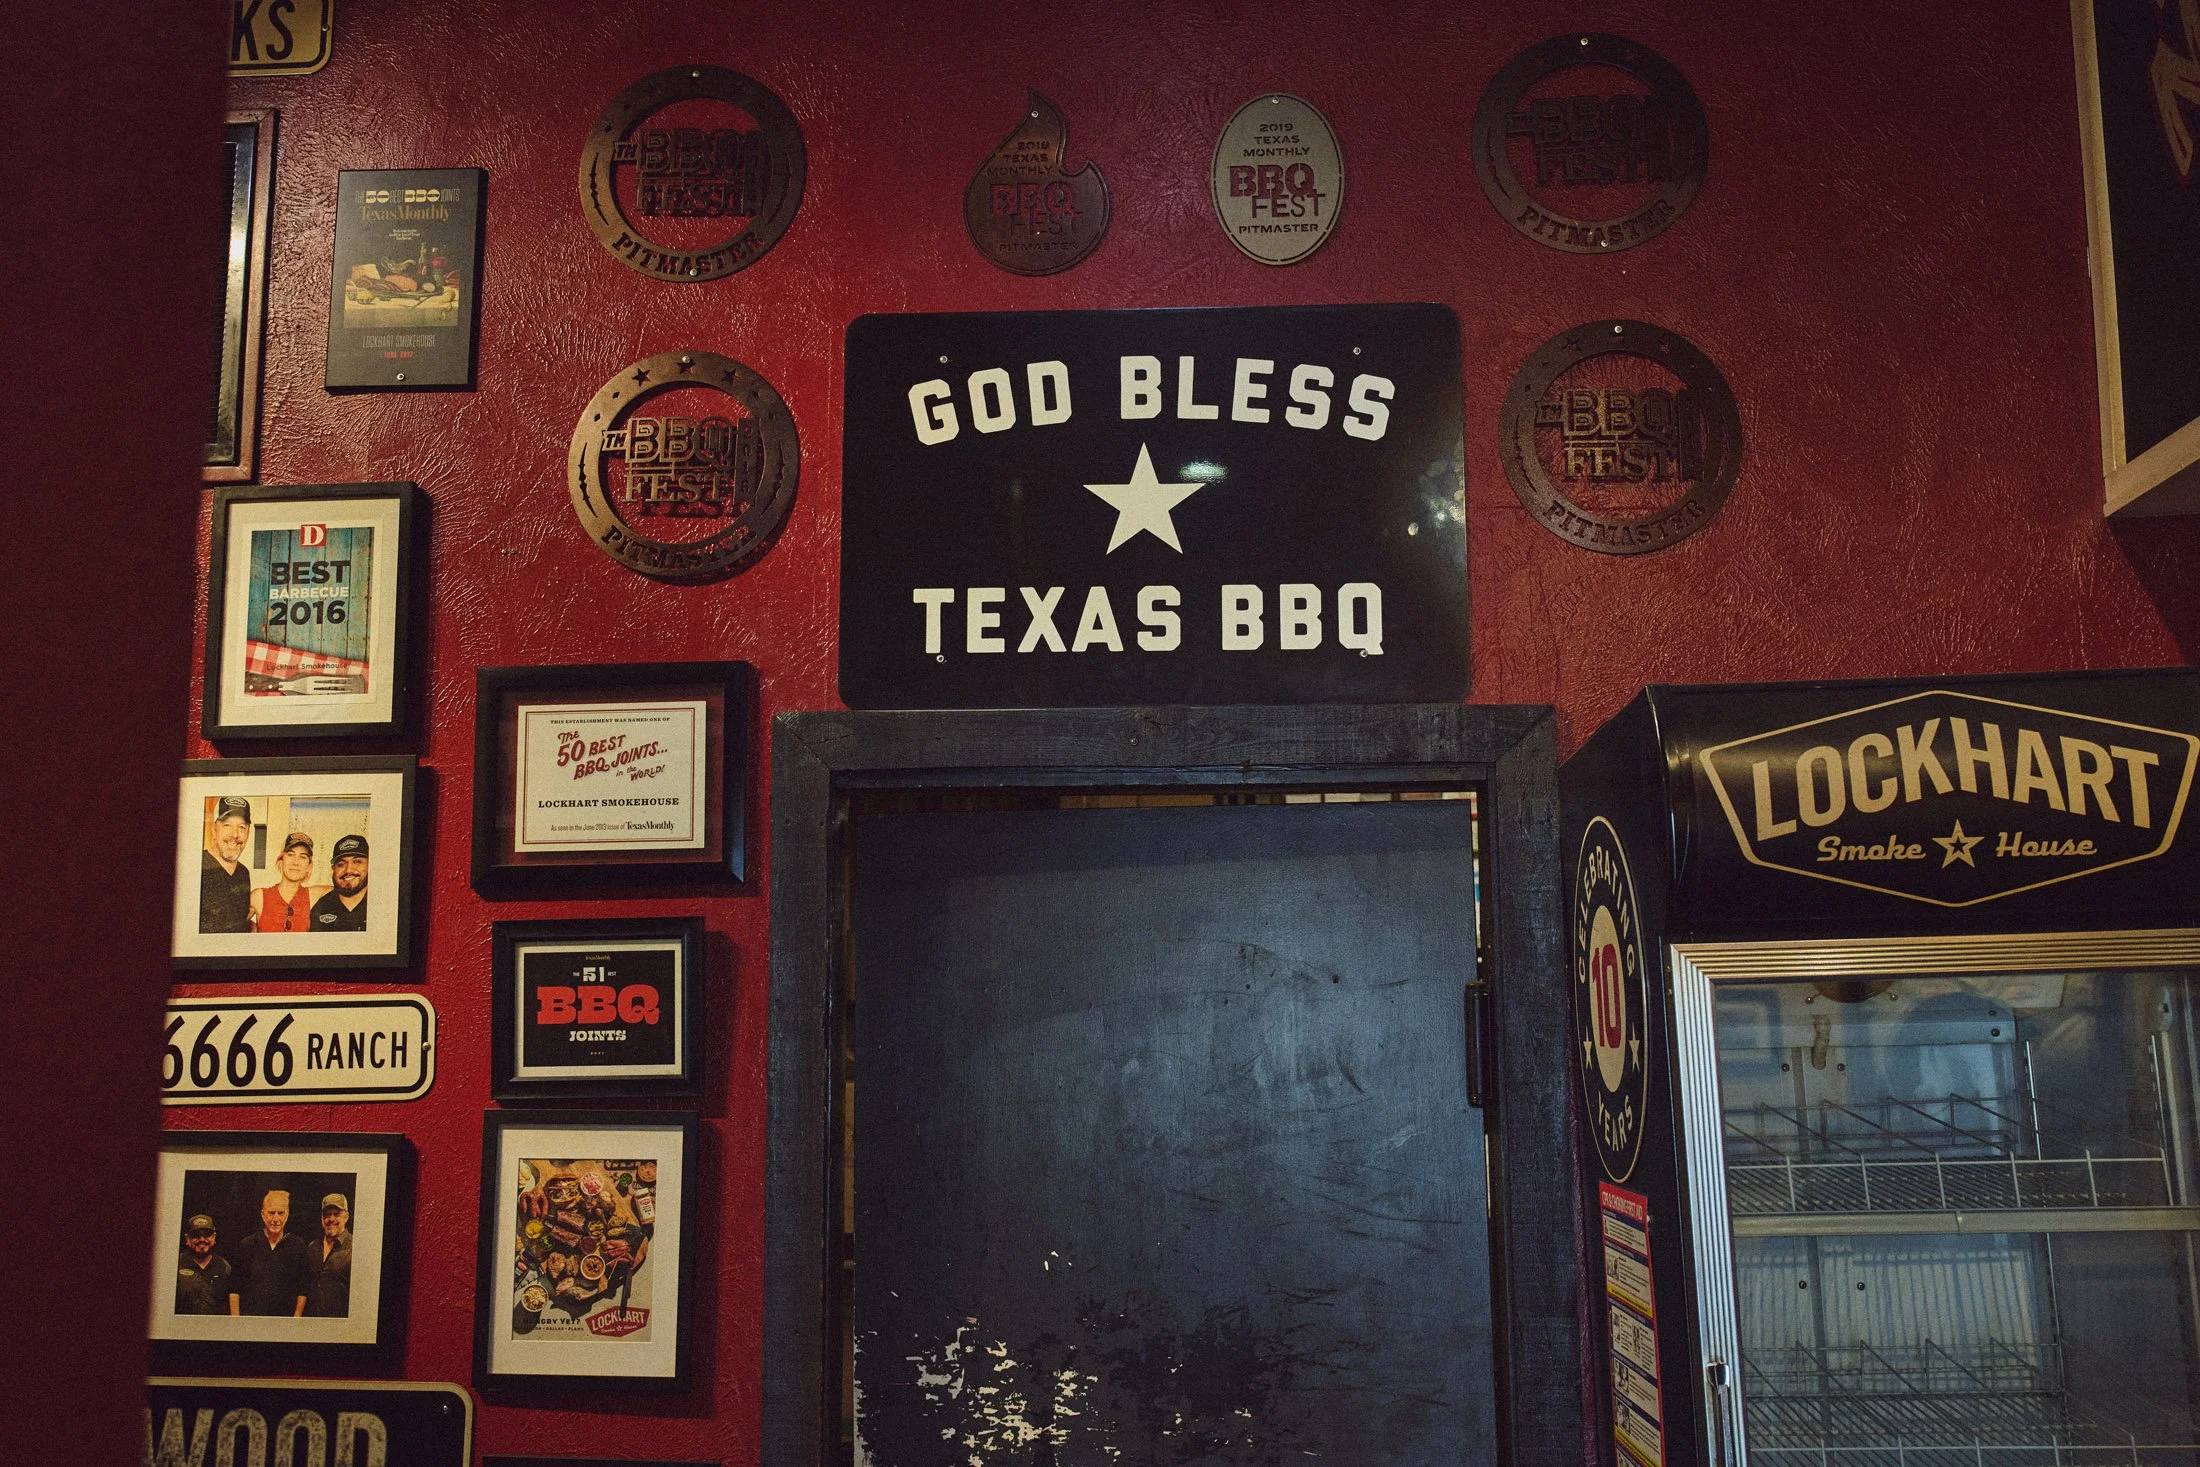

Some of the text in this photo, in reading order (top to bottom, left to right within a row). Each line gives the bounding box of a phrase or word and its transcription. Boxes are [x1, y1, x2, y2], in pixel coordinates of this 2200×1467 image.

[1254, 135, 1300, 144] TEXAS
[1259, 123, 1293, 132] 2019
[636, 128, 746, 180] BBQ
[1003, 154, 1048, 162] TEXAS
[1243, 147, 1310, 157] MONTHLY
[987, 166, 1052, 176] MONTHLY
[1229, 163, 1316, 199] BBQ
[990, 181, 1074, 216] BBQ
[1252, 194, 1325, 218] FEST
[1011, 212, 1083, 235] FEST
[1239, 223, 1319, 234] PITMASTER
[1517, 199, 1676, 247] PITMASTER
[612, 231, 765, 276] PITMASTER
[1000, 242, 1077, 251] PITMASTER
[908, 355, 1396, 446] GOD BLESS
[1563, 388, 1676, 445] BBQ
[625, 416, 734, 470] BBQ
[1564, 446, 1675, 478] FEST
[622, 472, 732, 503] FEST
[302, 525, 324, 546] D
[1542, 500, 1706, 546] PITMASTER
[601, 525, 757, 569] PITMASTER
[270, 560, 350, 585] BEST
[269, 586, 349, 599] BARBECUE
[269, 600, 346, 625] 2016
[913, 583, 1384, 655] TEXAS BBQ
[301, 662, 348, 670] Smokehouse
[557, 735, 627, 767] 50 BEST
[574, 741, 668, 780] BBQ JOINTS...
[616, 765, 637, 777] in the
[1752, 717, 2159, 841] LOCKHART
[538, 798, 680, 808] LOCKHART SMOKEHOUSE
[1817, 832, 2097, 862] Smoke House
[1578, 846, 1635, 984] CELEBRATING
[583, 966, 605, 982] 51
[537, 984, 660, 1025] BBQ
[1591, 944, 1621, 1049] 10
[160, 1013, 408, 1089] 6666 RANCH
[569, 1030, 627, 1042] JOINTS
[1598, 1090, 1634, 1152] YEARS
